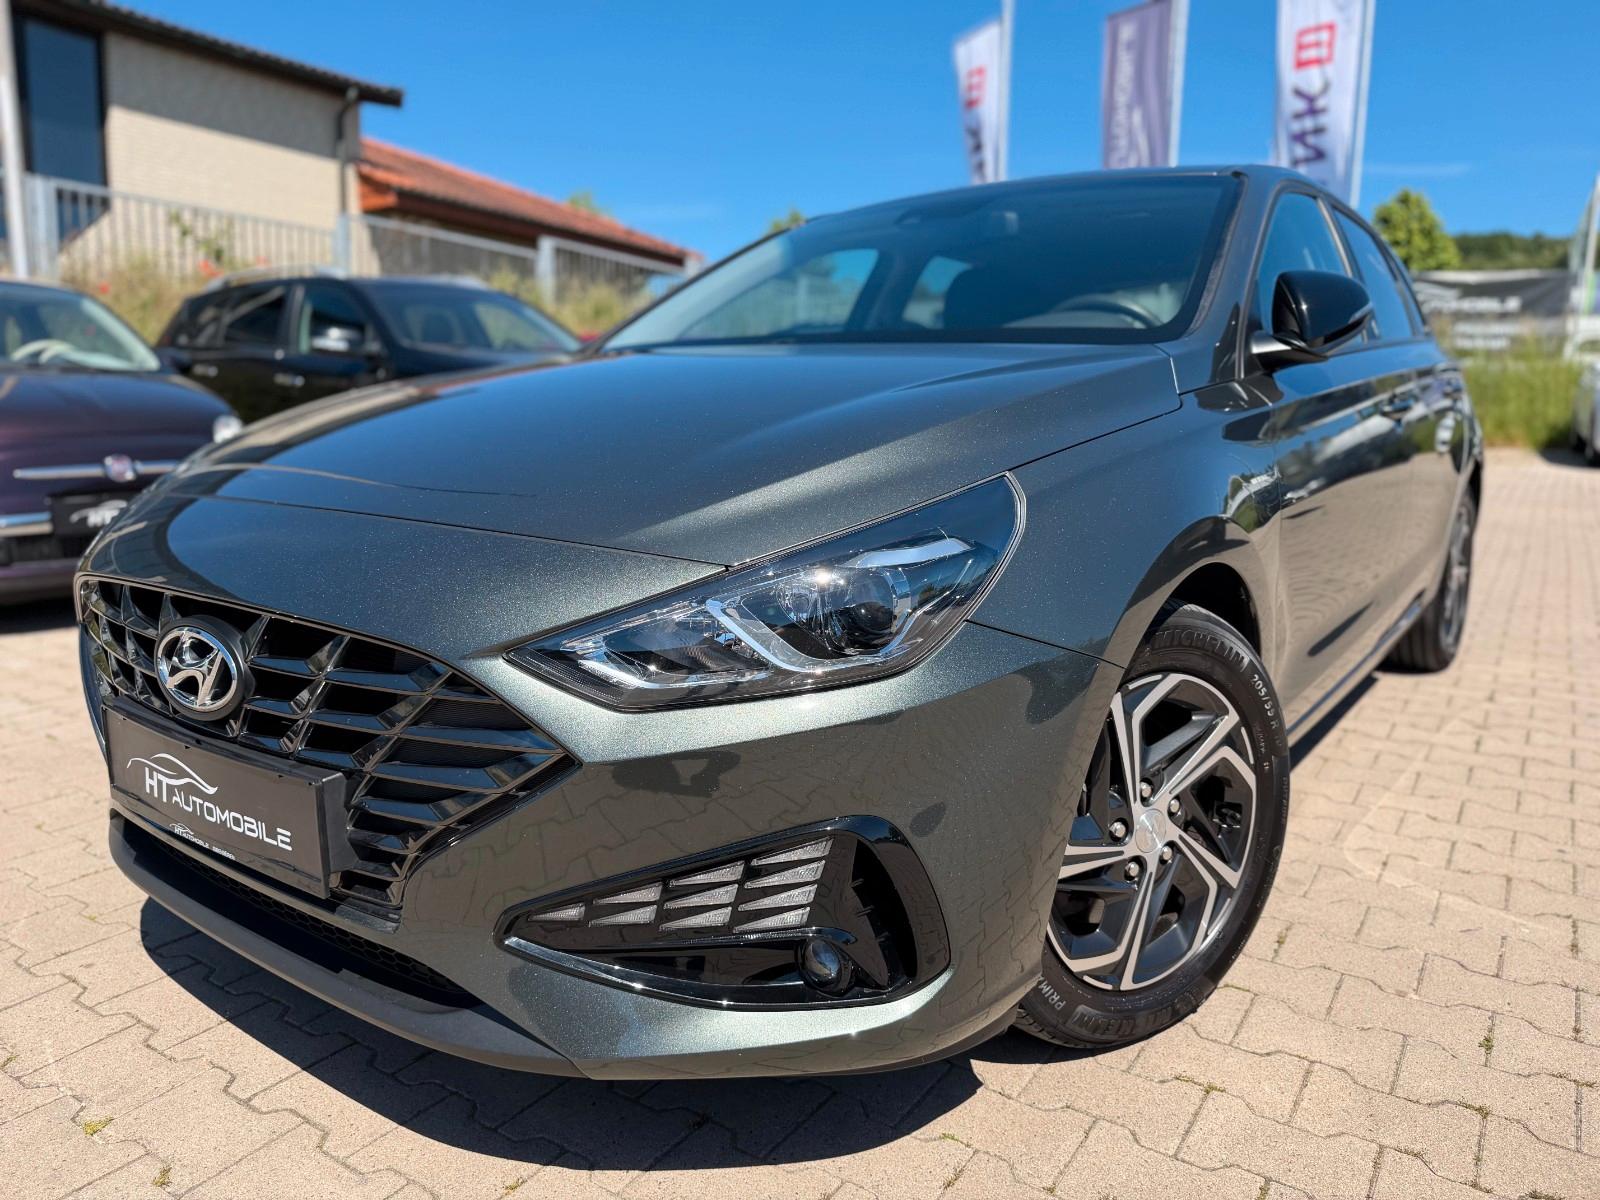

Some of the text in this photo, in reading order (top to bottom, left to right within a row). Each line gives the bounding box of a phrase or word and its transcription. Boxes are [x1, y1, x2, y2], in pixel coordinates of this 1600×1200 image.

[1251, 674, 1275, 717] 205/55
[145, 767, 178, 803] HT
[172, 788, 292, 851] AUTOMOBILE
